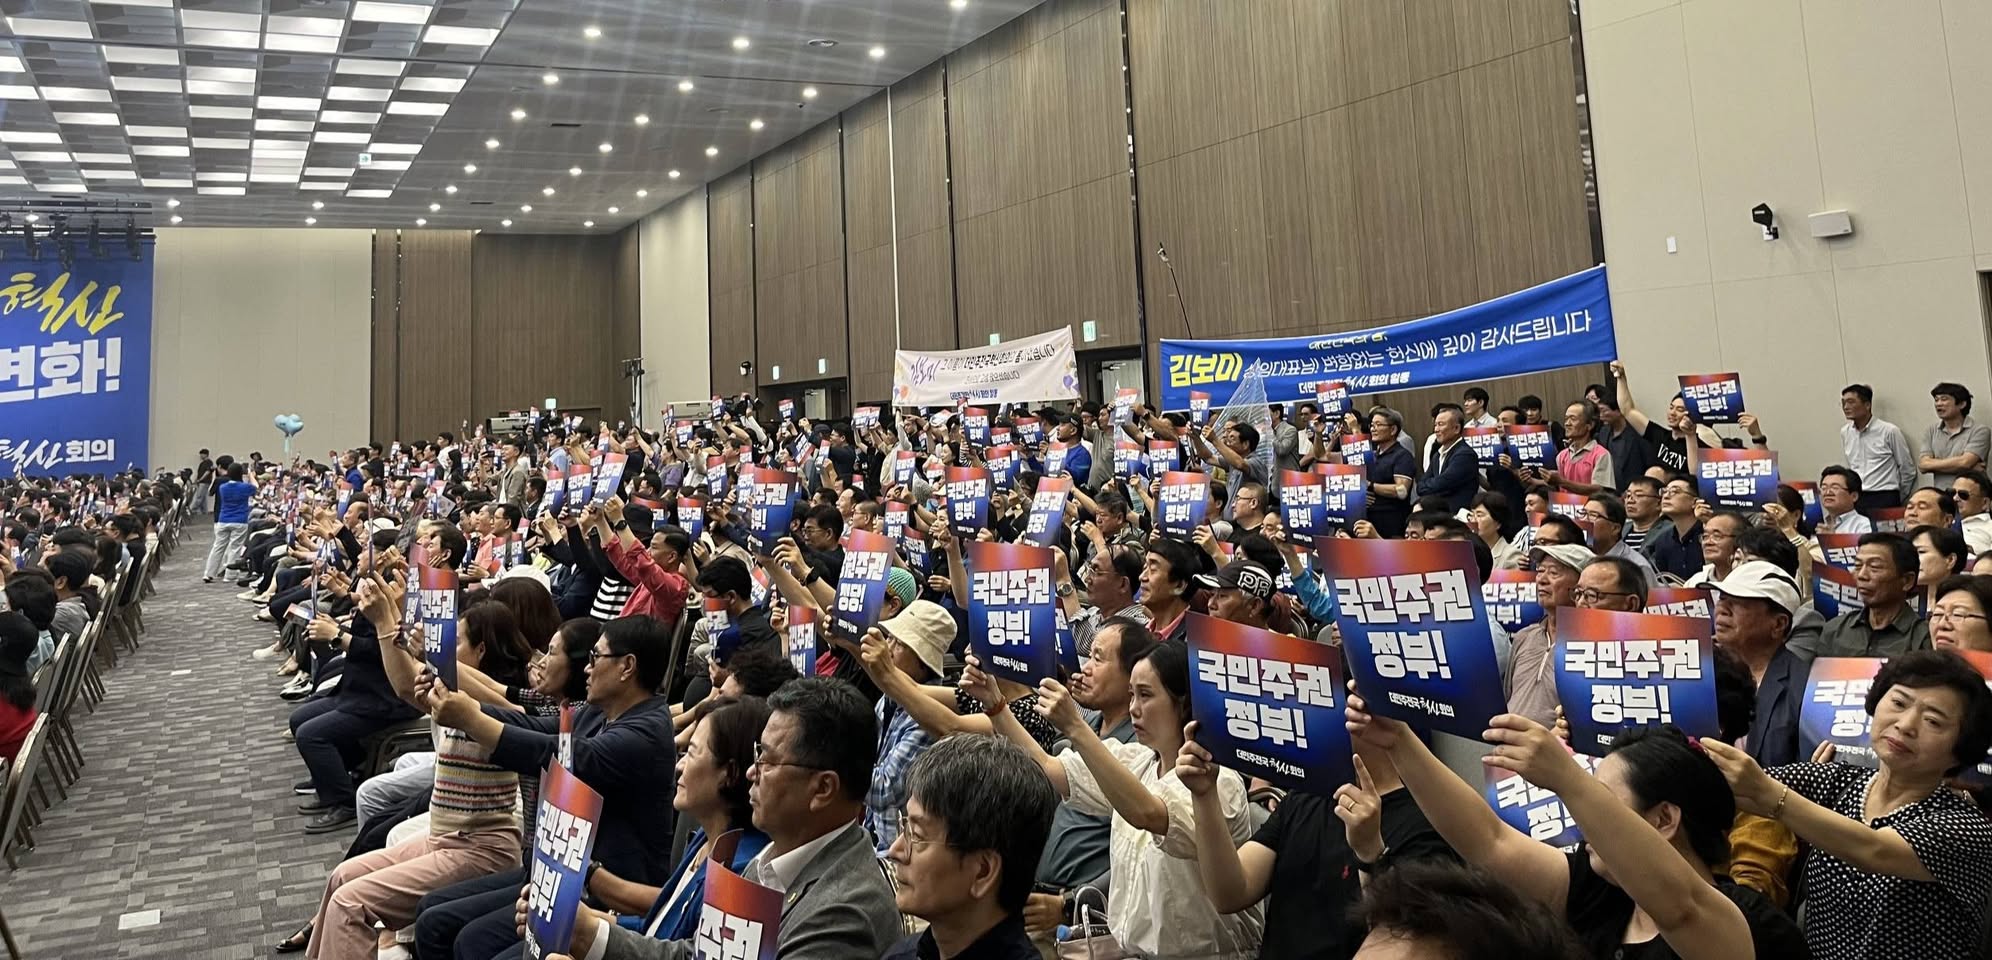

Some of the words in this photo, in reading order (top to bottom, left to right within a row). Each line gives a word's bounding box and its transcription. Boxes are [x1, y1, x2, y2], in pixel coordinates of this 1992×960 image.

[1169, 352, 1243, 388] 김보미
[1322, 350, 1385, 373] 변함없는
[1386, 339, 1437, 365] 헌신에
[1441, 332, 1476, 358] 깊이
[1480, 309, 1592, 350] 감사드립니다
[1684, 379, 1737, 399] 국민주권
[1696, 397, 1728, 413] 정부!
[1509, 431, 1549, 446] 국민주권
[1518, 445, 1544, 460] 정부!
[1657, 443, 1687, 470] VLTN
[1701, 458, 1772, 478] 당원주권
[947, 479, 987, 500] 국민주권
[1160, 483, 1205, 503] 국민주권
[1281, 484, 1322, 506] 국민주권
[1325, 474, 1361, 492] 주권
[1716, 478, 1756, 496] 정당!
[954, 500, 976, 521] 정부!
[1165, 503, 1190, 523] 정부!
[1327, 493, 1347, 511] 부!
[1289, 508, 1312, 528] 정부!
[840, 551, 888, 581] 원주권
[838, 583, 867, 612] 정당!
[973, 567, 1050, 606] 국민주권
[1334, 569, 1474, 624] 국민주권
[1482, 582, 1536, 603] 민주권
[1819, 578, 1865, 606] 국민
[987, 609, 1031, 645] 정부!
[1367, 630, 1452, 679] 정부!
[1565, 639, 1701, 679] 국민주권
[1198, 650, 1334, 708] 국민주권
[1591, 685, 1673, 724] 정부!
[1814, 680, 1873, 706] 국민
[1225, 699, 1308, 749] 정부!
[529, 858, 562, 923] 정부!
